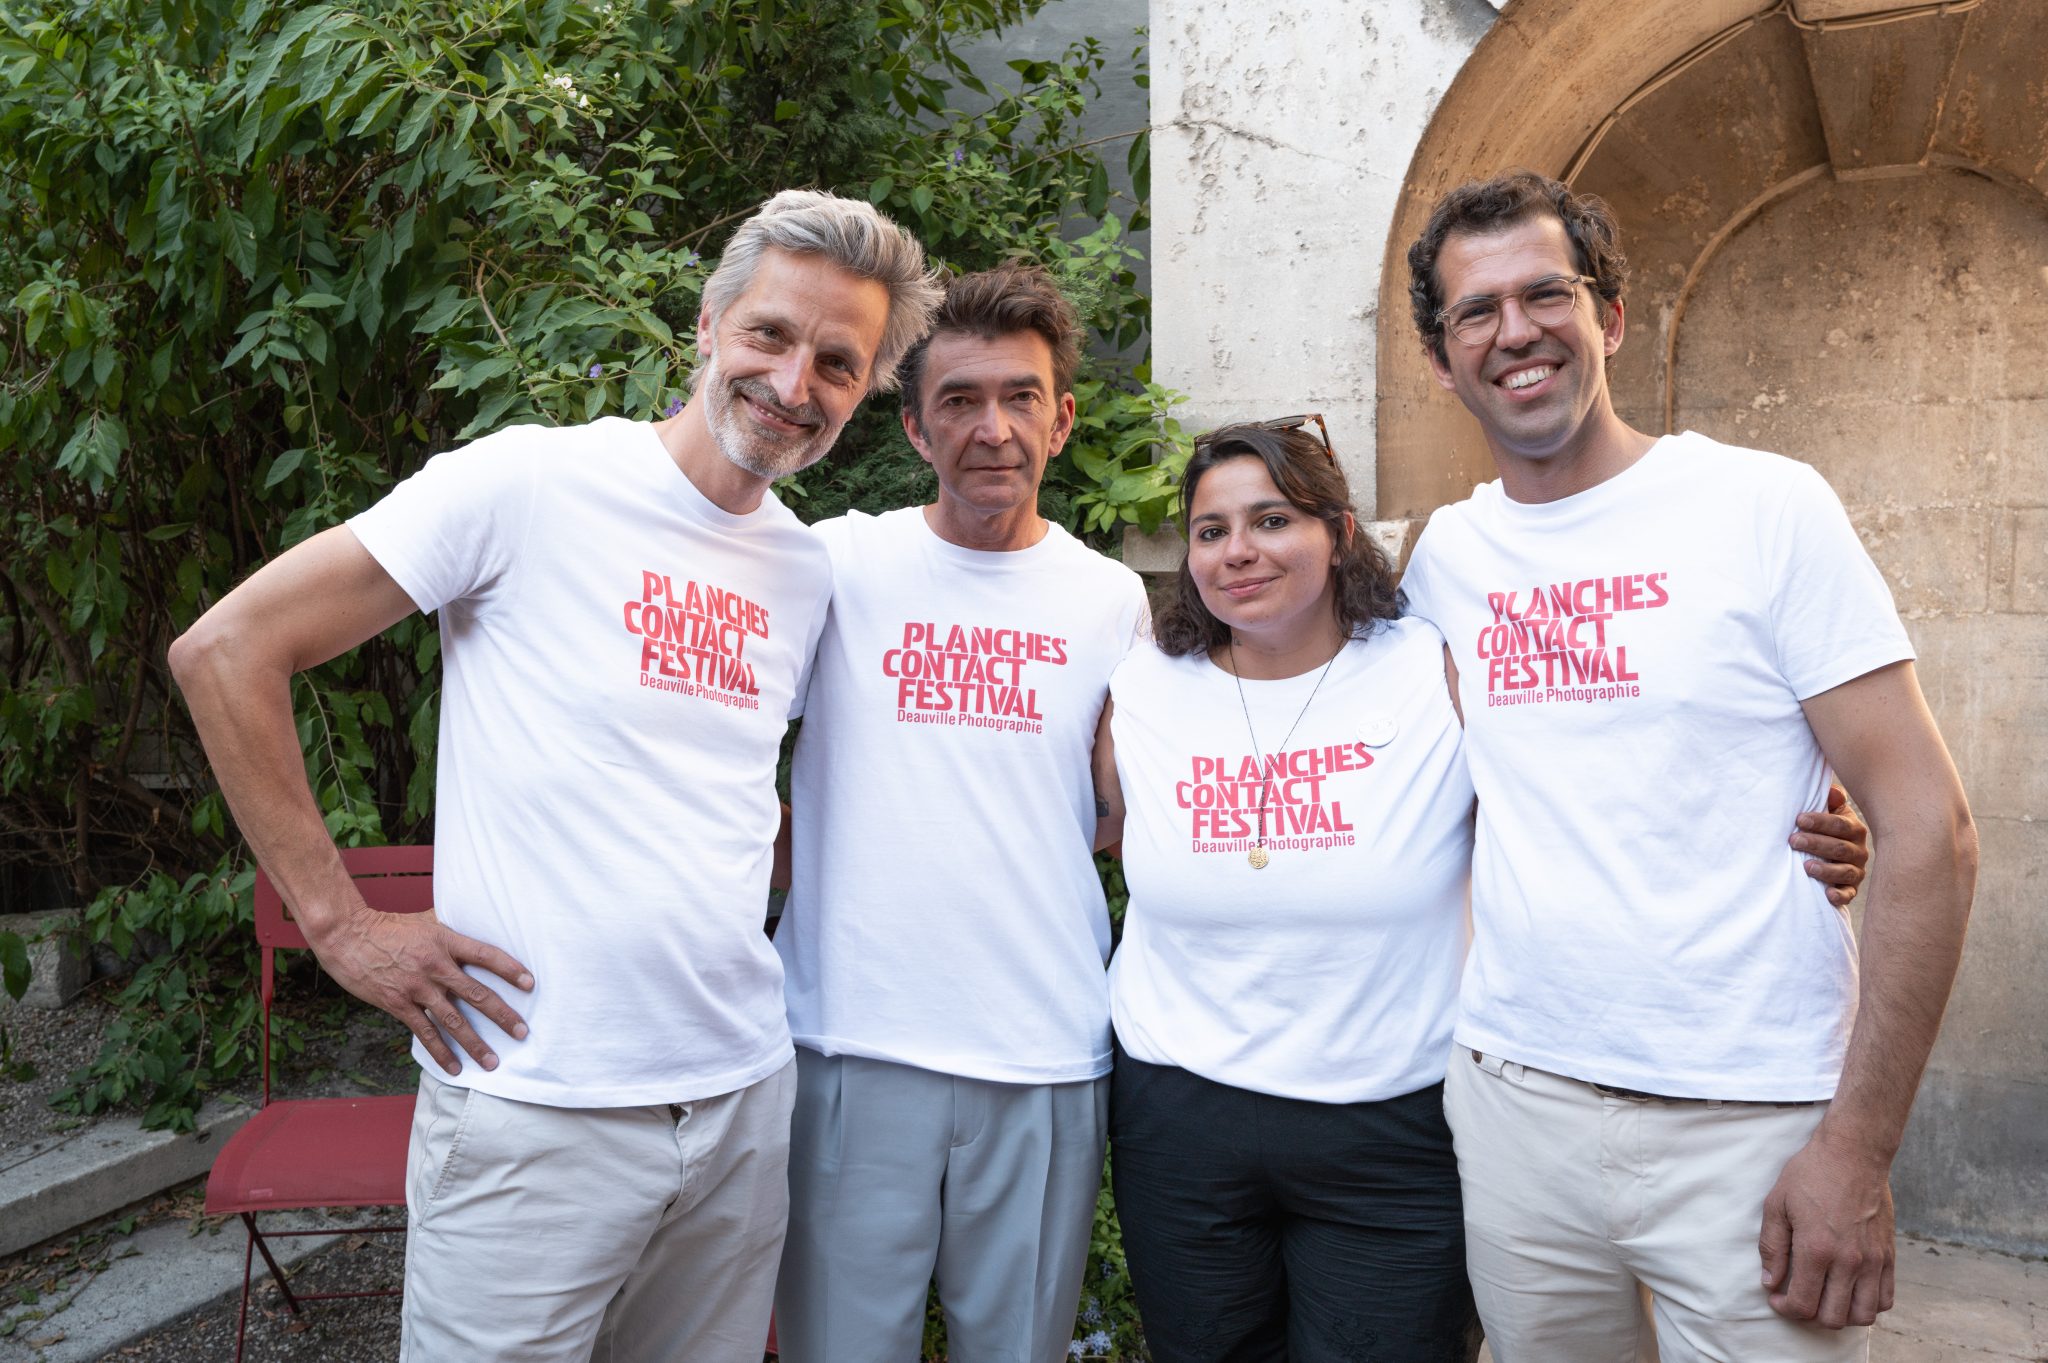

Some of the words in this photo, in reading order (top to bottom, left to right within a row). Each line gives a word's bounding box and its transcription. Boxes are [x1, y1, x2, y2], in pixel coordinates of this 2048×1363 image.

[642, 570, 769, 640] PLANCHES
[1487, 572, 1669, 624] PLANCHES
[623, 601, 748, 660] CONTACT
[902, 622, 1067, 665] PLANCHES
[1477, 613, 1613, 659] CONTACT
[641, 637, 760, 696] FESTIVAL
[882, 649, 1027, 686] CONTACT
[1488, 646, 1639, 692] FESTIVAL
[640, 672, 694, 696] Deauville
[696, 684, 759, 710] Photographie
[898, 678, 1043, 721] FESTIVAL
[1488, 689, 1544, 707] Deauville
[1546, 683, 1640, 703] Photographie
[897, 709, 956, 725] Deauville
[958, 714, 1042, 734] Photographie
[1192, 742, 1375, 785] PLANCHES
[1175, 775, 1326, 809] CONTACT
[1192, 801, 1353, 839] FESTIVAL
[1192, 839, 1256, 853] Deauville
[1258, 833, 1355, 852] Photographie
